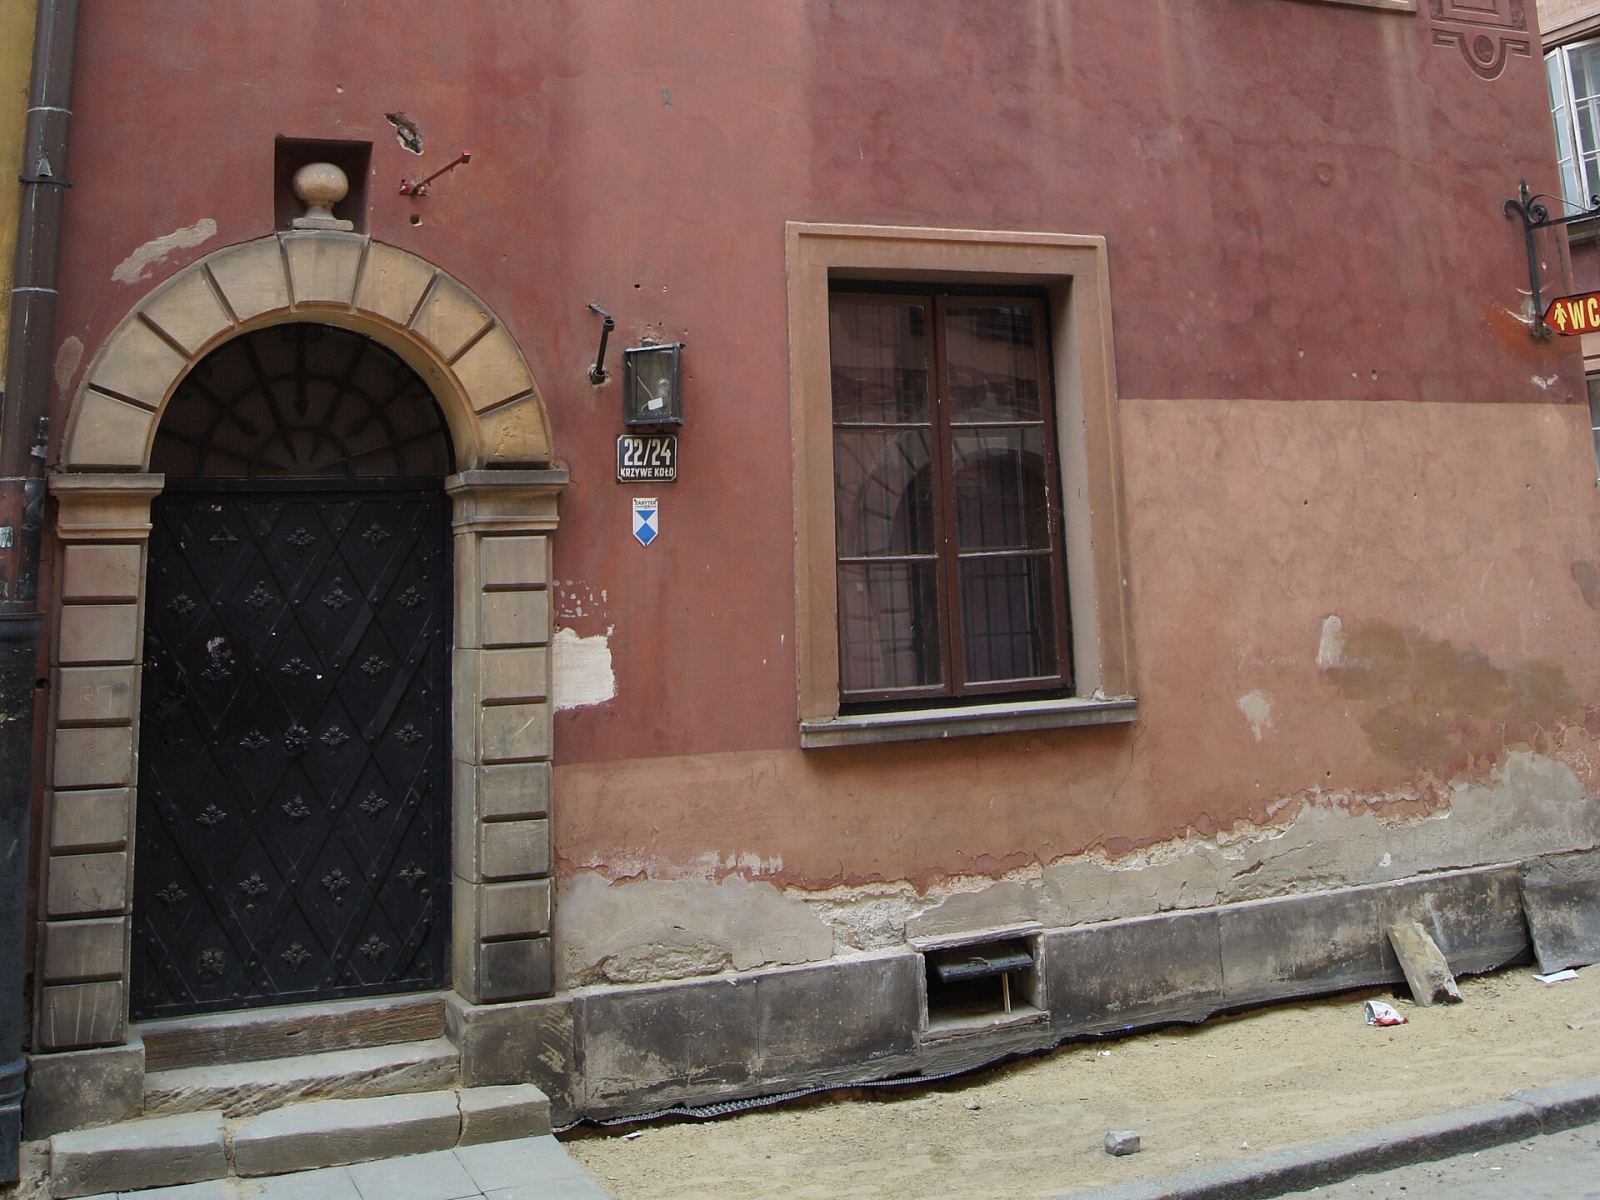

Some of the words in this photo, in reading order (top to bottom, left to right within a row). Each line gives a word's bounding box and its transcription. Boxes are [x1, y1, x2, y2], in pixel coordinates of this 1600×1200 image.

[1567, 298, 1600, 329] WC
[624, 438, 671, 466] 22/24
[620, 467, 653, 477] KRZYWE
[655, 467, 674, 477] KOŁO
